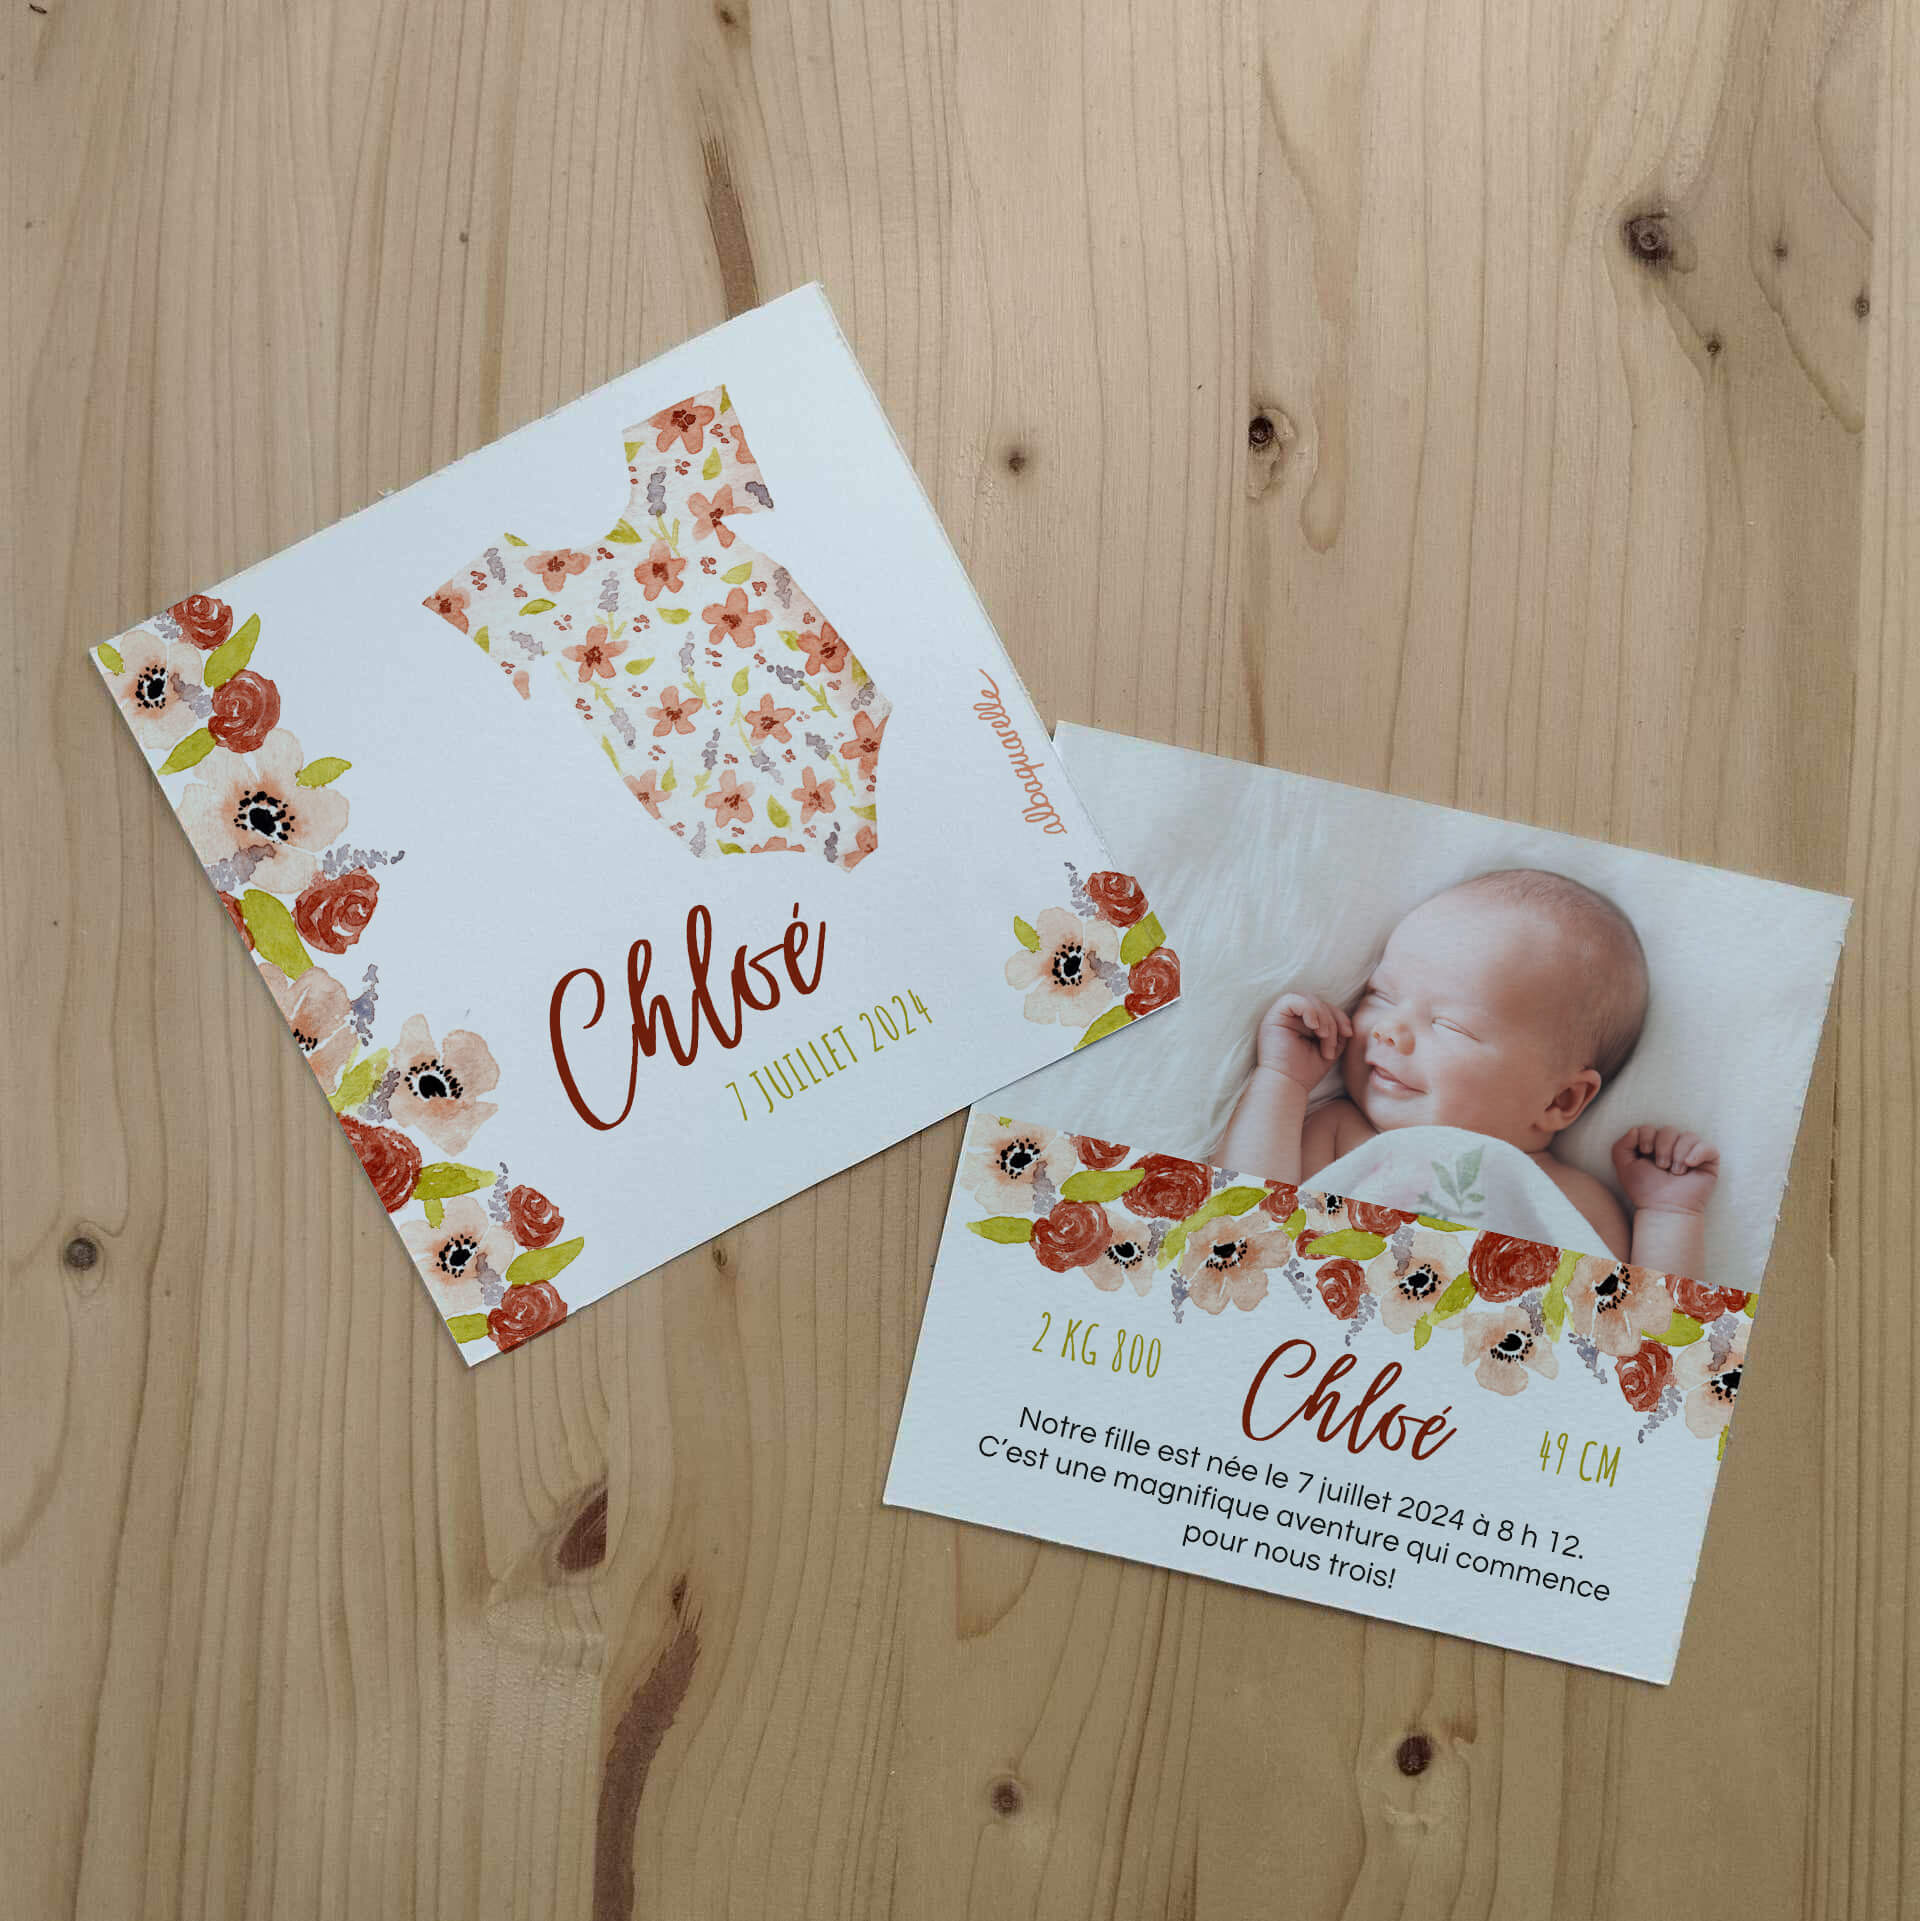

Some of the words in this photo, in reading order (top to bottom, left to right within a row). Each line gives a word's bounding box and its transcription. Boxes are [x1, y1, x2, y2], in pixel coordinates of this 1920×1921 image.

[972, 669, 1067, 834] albaquarelle
[550, 902, 826, 1131] Chloé
[725, 1081, 748, 1121] 7
[749, 1025, 858, 1114] JUILLET
[859, 988, 933, 1053] 2024
[1031, 1311, 1051, 1353] 2
[1060, 1318, 1100, 1366] KG
[1111, 1328, 1162, 1378] 800
[1242, 1338, 1457, 1461] Chloé
[1018, 1406, 1097, 1444] Notre
[1104, 1426, 1150, 1457] fille
[1157, 1444, 1200, 1469] est
[1206, 1456, 1258, 1481] née
[1264, 1463, 1289, 1489] le
[1297, 1471, 1314, 1494] 7
[1318, 1477, 1392, 1513] juillet
[1397, 1496, 1465, 1531] 2024
[1472, 1513, 1490, 1537] à
[1497, 1519, 1514, 1542] 8
[1520, 1524, 1538, 1548] h
[1550, 1531, 1584, 1560] 12.
[1539, 1430, 1569, 1475] 49
[1579, 1441, 1621, 1488] CM
[1055, 1456, 1107, 1483] une
[1113, 1470, 1269, 1521] magnifique
[1276, 1509, 1400, 1552] aventure
[1406, 1539, 1450, 1566] qui
[1455, 1551, 1610, 1602] commence
[1182, 1524, 1250, 1555] pour
[1254, 1540, 1322, 1573] nous
[1328, 1552, 1397, 1590] trois!
